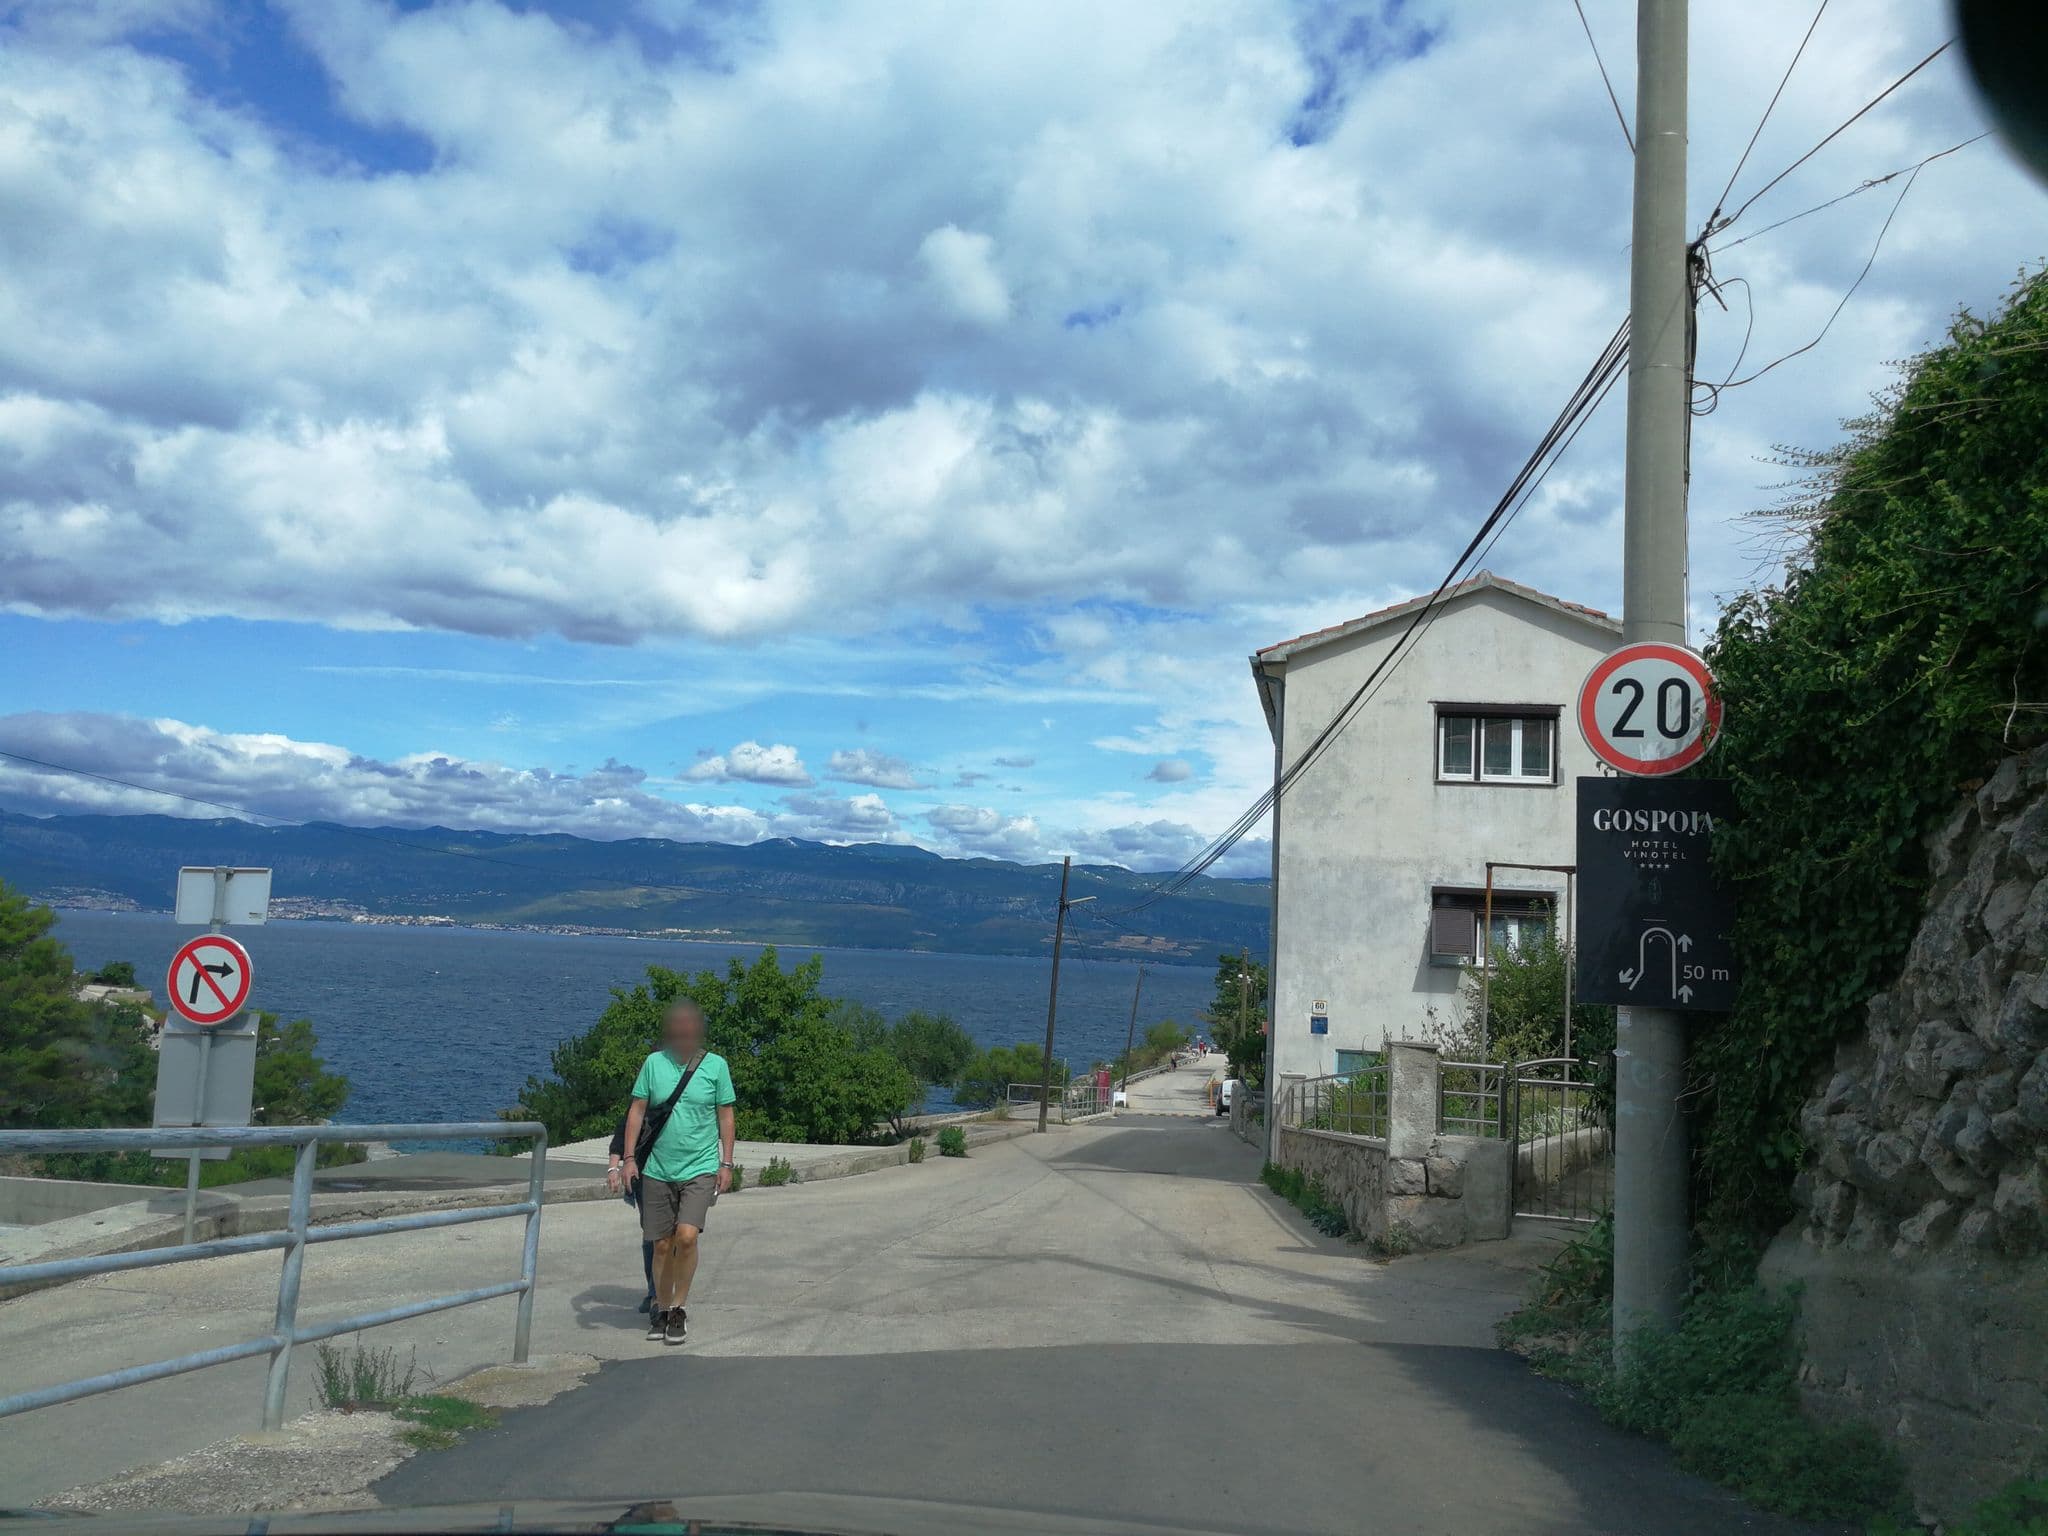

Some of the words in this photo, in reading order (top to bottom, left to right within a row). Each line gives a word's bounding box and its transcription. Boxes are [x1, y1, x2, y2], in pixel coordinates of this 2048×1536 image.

[1612, 678, 1691, 739] 20
[1593, 808, 1714, 836] GOSPOJA
[1631, 840, 1678, 849] HOTEL
[1623, 850, 1687, 860] VINOTEL
[1683, 965, 1705, 980] 50
[1712, 969, 1729, 981] m
